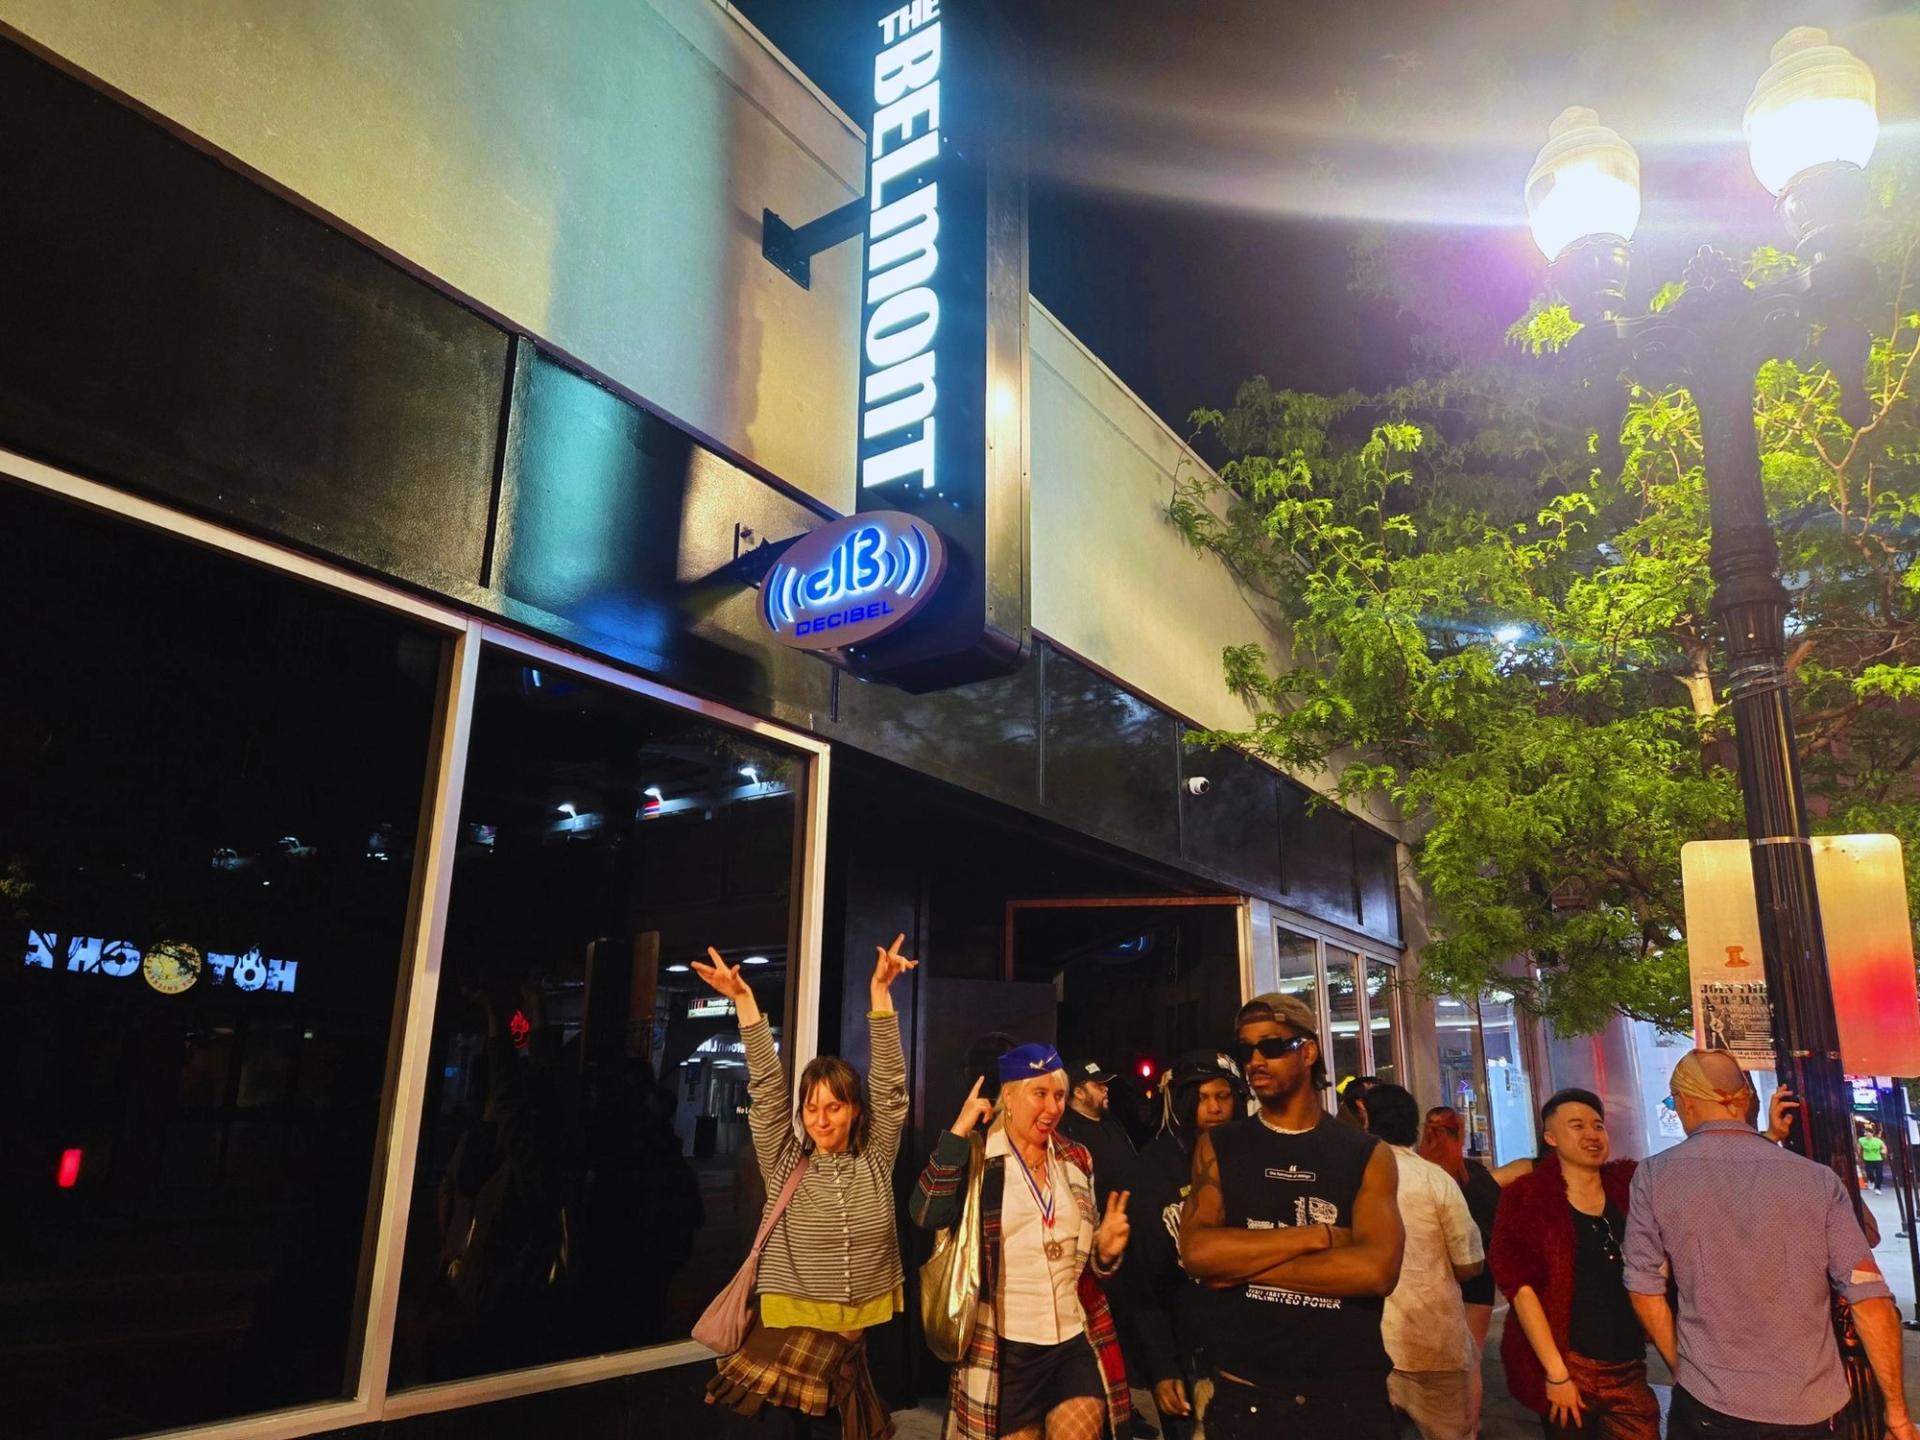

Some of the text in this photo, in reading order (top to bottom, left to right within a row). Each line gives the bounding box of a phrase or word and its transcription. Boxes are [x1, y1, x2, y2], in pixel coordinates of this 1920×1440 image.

[878, 0, 940, 45] THE
[795, 601, 894, 637] DECIBEL
[1701, 983, 1767, 994] JOIN THE
[1245, 1288, 1341, 1310] UNLIMITED POWER
